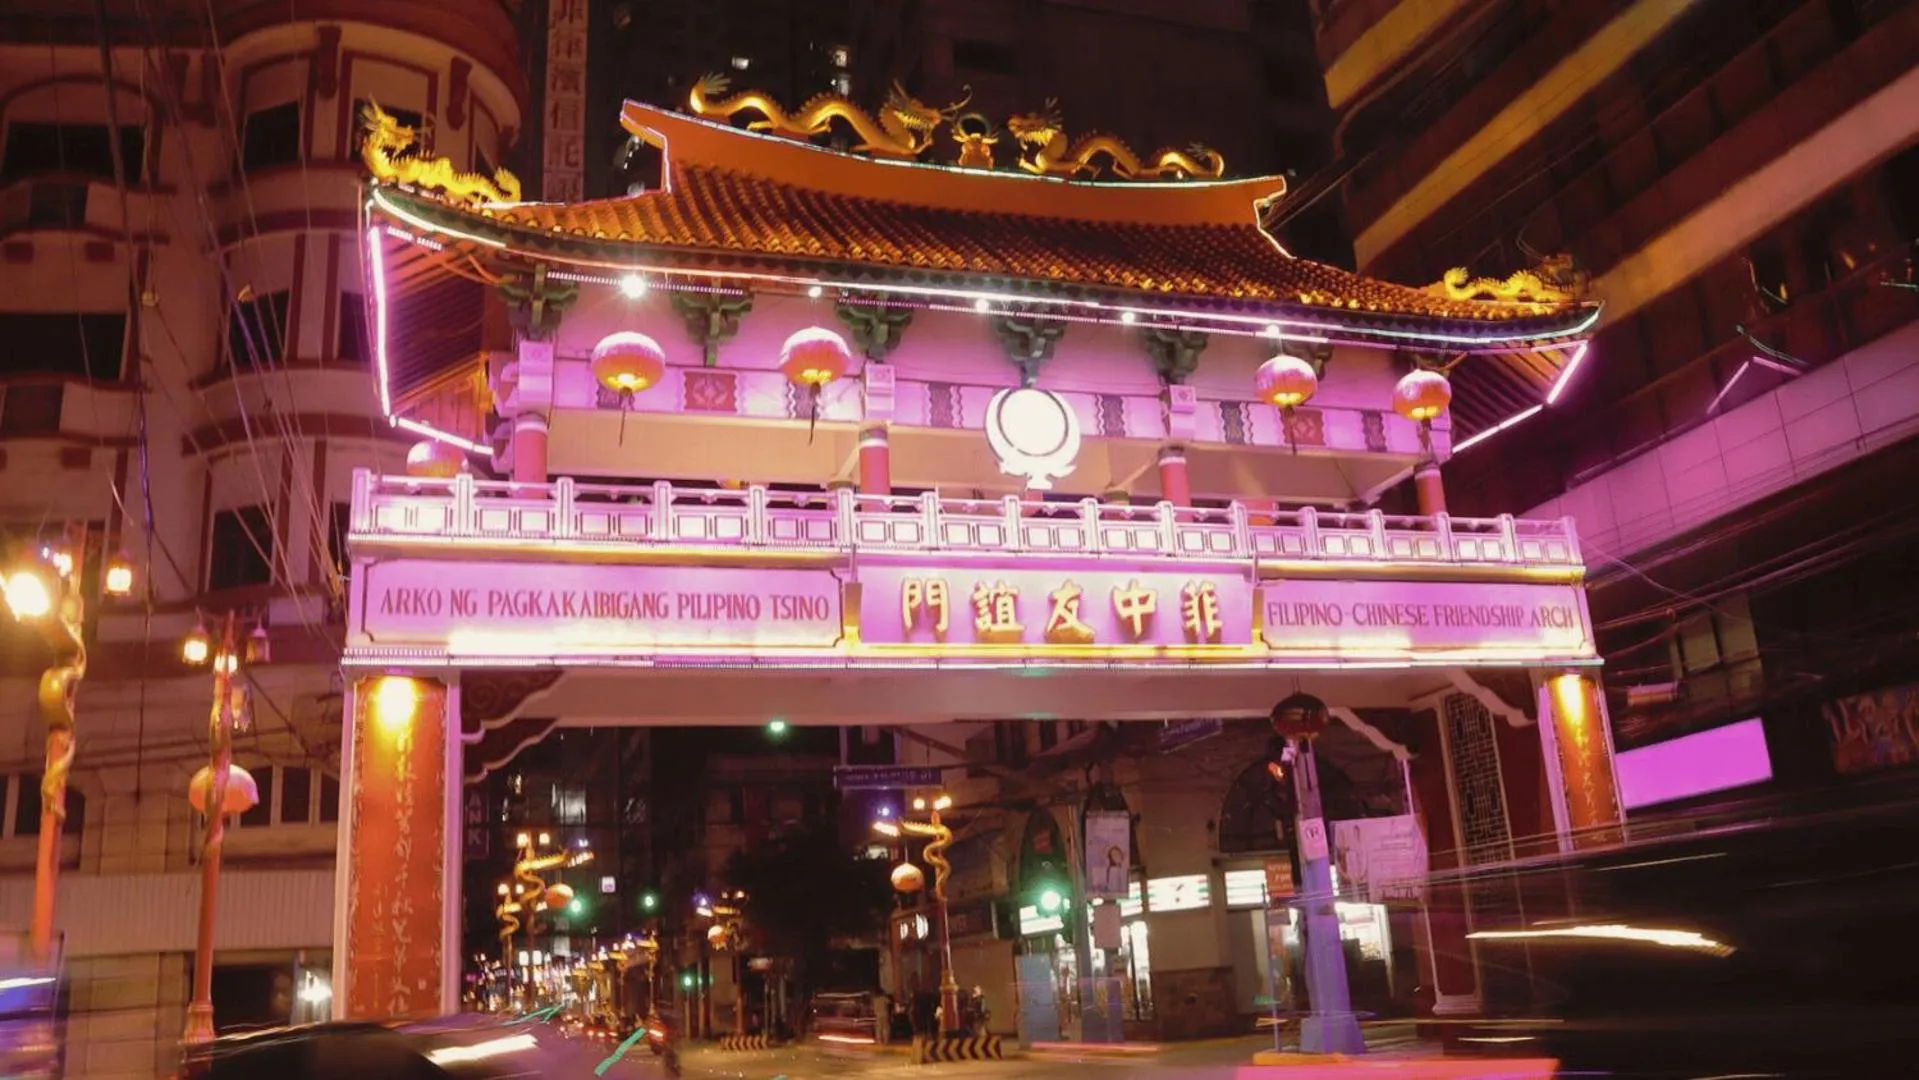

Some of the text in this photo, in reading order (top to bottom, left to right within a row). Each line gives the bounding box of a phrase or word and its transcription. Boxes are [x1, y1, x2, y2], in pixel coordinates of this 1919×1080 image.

[380, 588, 830, 621] ARKO NG PAGKAKAIBIGANG PILIPINO TSINO
[1434, 603, 1524, 628] FRIENDSHIP
[1529, 606, 1574, 629] ARCH
